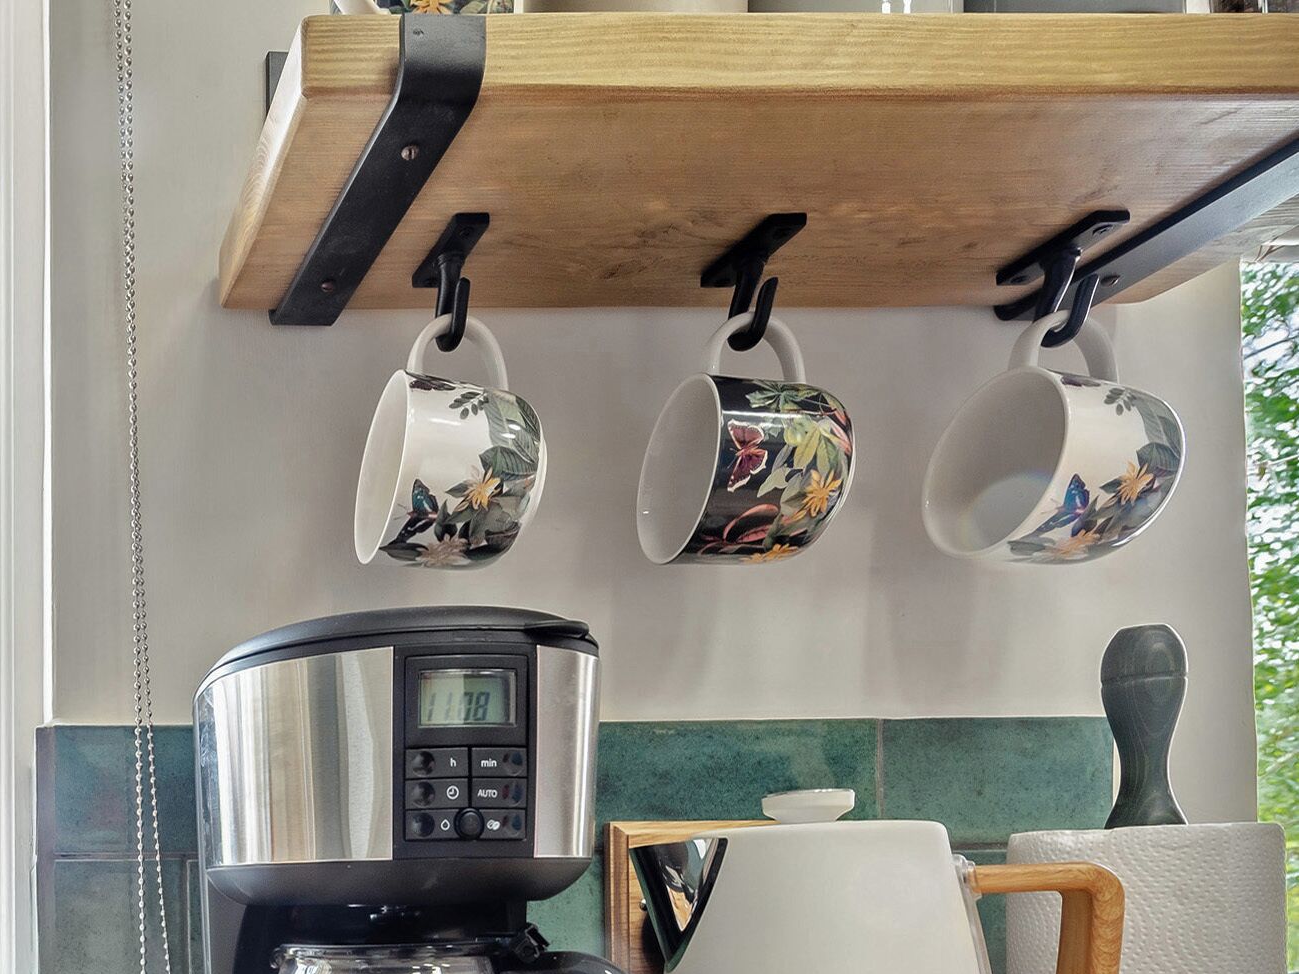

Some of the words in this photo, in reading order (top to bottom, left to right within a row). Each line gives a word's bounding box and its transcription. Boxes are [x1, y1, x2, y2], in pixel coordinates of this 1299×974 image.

[450, 757, 457, 767] h
[480, 758, 497, 767] min
[477, 789, 498, 798] AUTO
